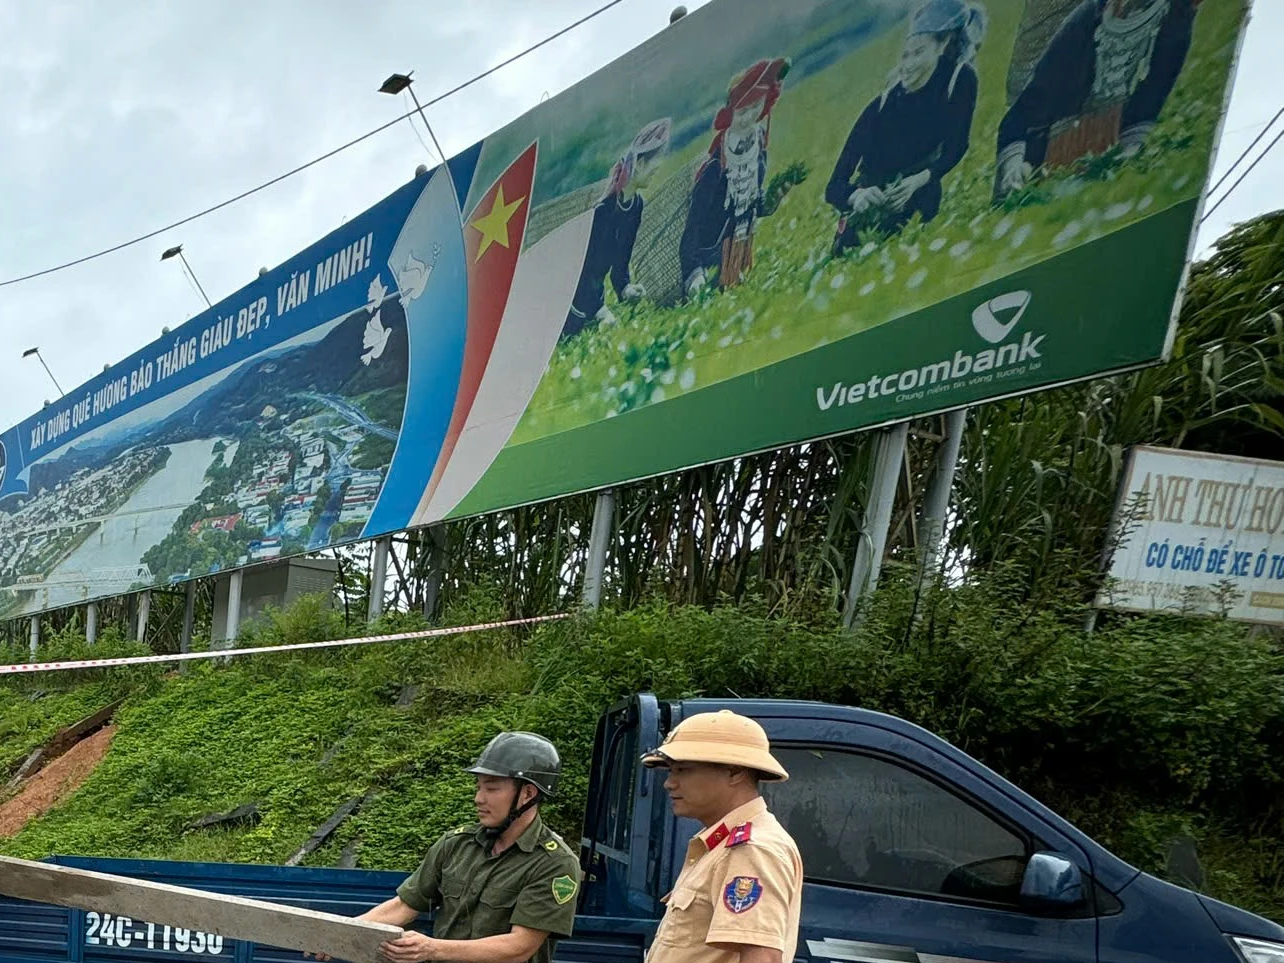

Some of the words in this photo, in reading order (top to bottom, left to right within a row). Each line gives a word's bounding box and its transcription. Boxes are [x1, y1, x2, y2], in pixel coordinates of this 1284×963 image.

[30, 419, 47, 451] XÂY
[47, 409, 71, 443] DỰNG
[72, 392, 92, 429] QUÊ
[92, 376, 128, 417] HƯƠNG
[129, 359, 153, 396] BẢO
[156, 336, 196, 382] THẮNG
[200, 314, 234, 359] GIÀU
[236, 296, 271, 340] ĐẸP,
[277, 270, 311, 317] VĂN
[314, 232, 374, 296] MINH!
[816, 331, 1047, 411] Vietcombank
[895, 390, 925, 403] Chung
[953, 379, 966, 390] tin
[1029, 362, 1042, 371] lai
[1191, 477, 1255, 530] THƯ
[1146, 538, 1170, 568] CÓ
[1171, 537, 1207, 572] CHỖ
[1205, 540, 1233, 574] ĐỂ
[1228, 551, 1253, 577] XE
